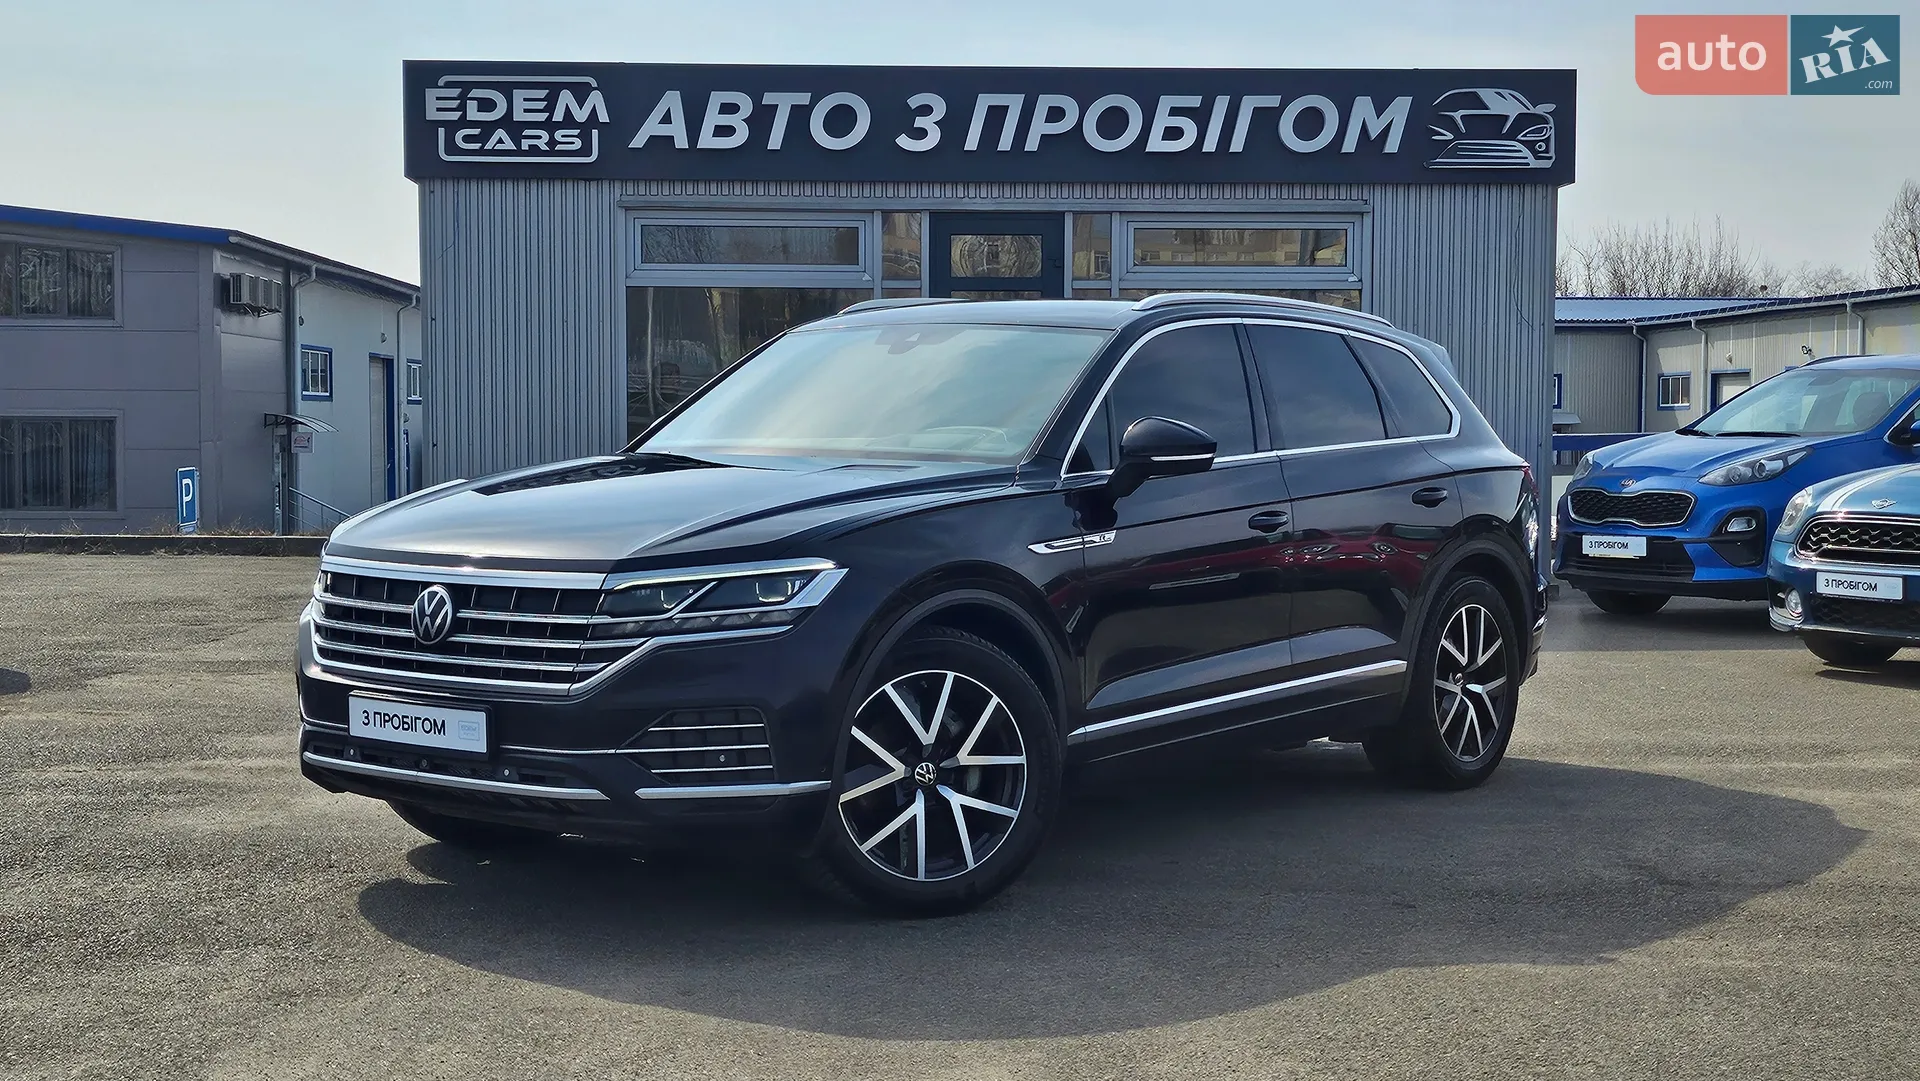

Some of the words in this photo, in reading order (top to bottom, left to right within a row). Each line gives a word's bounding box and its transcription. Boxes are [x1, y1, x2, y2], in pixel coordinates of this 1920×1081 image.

[425, 88, 610, 123] EDEM
[628, 91, 871, 151] АВТО
[895, 92, 947, 152] З
[963, 93, 1413, 154] ПРОБІГОМ
[454, 128, 583, 151] CARS
[182, 478, 193, 517] P
[1594, 541, 1629, 549] ПРОБІГОМ
[1831, 579, 1878, 592] ПРОБІГОМ
[362, 710, 371, 726] З
[373, 711, 446, 736] ПРОБІГОМ
